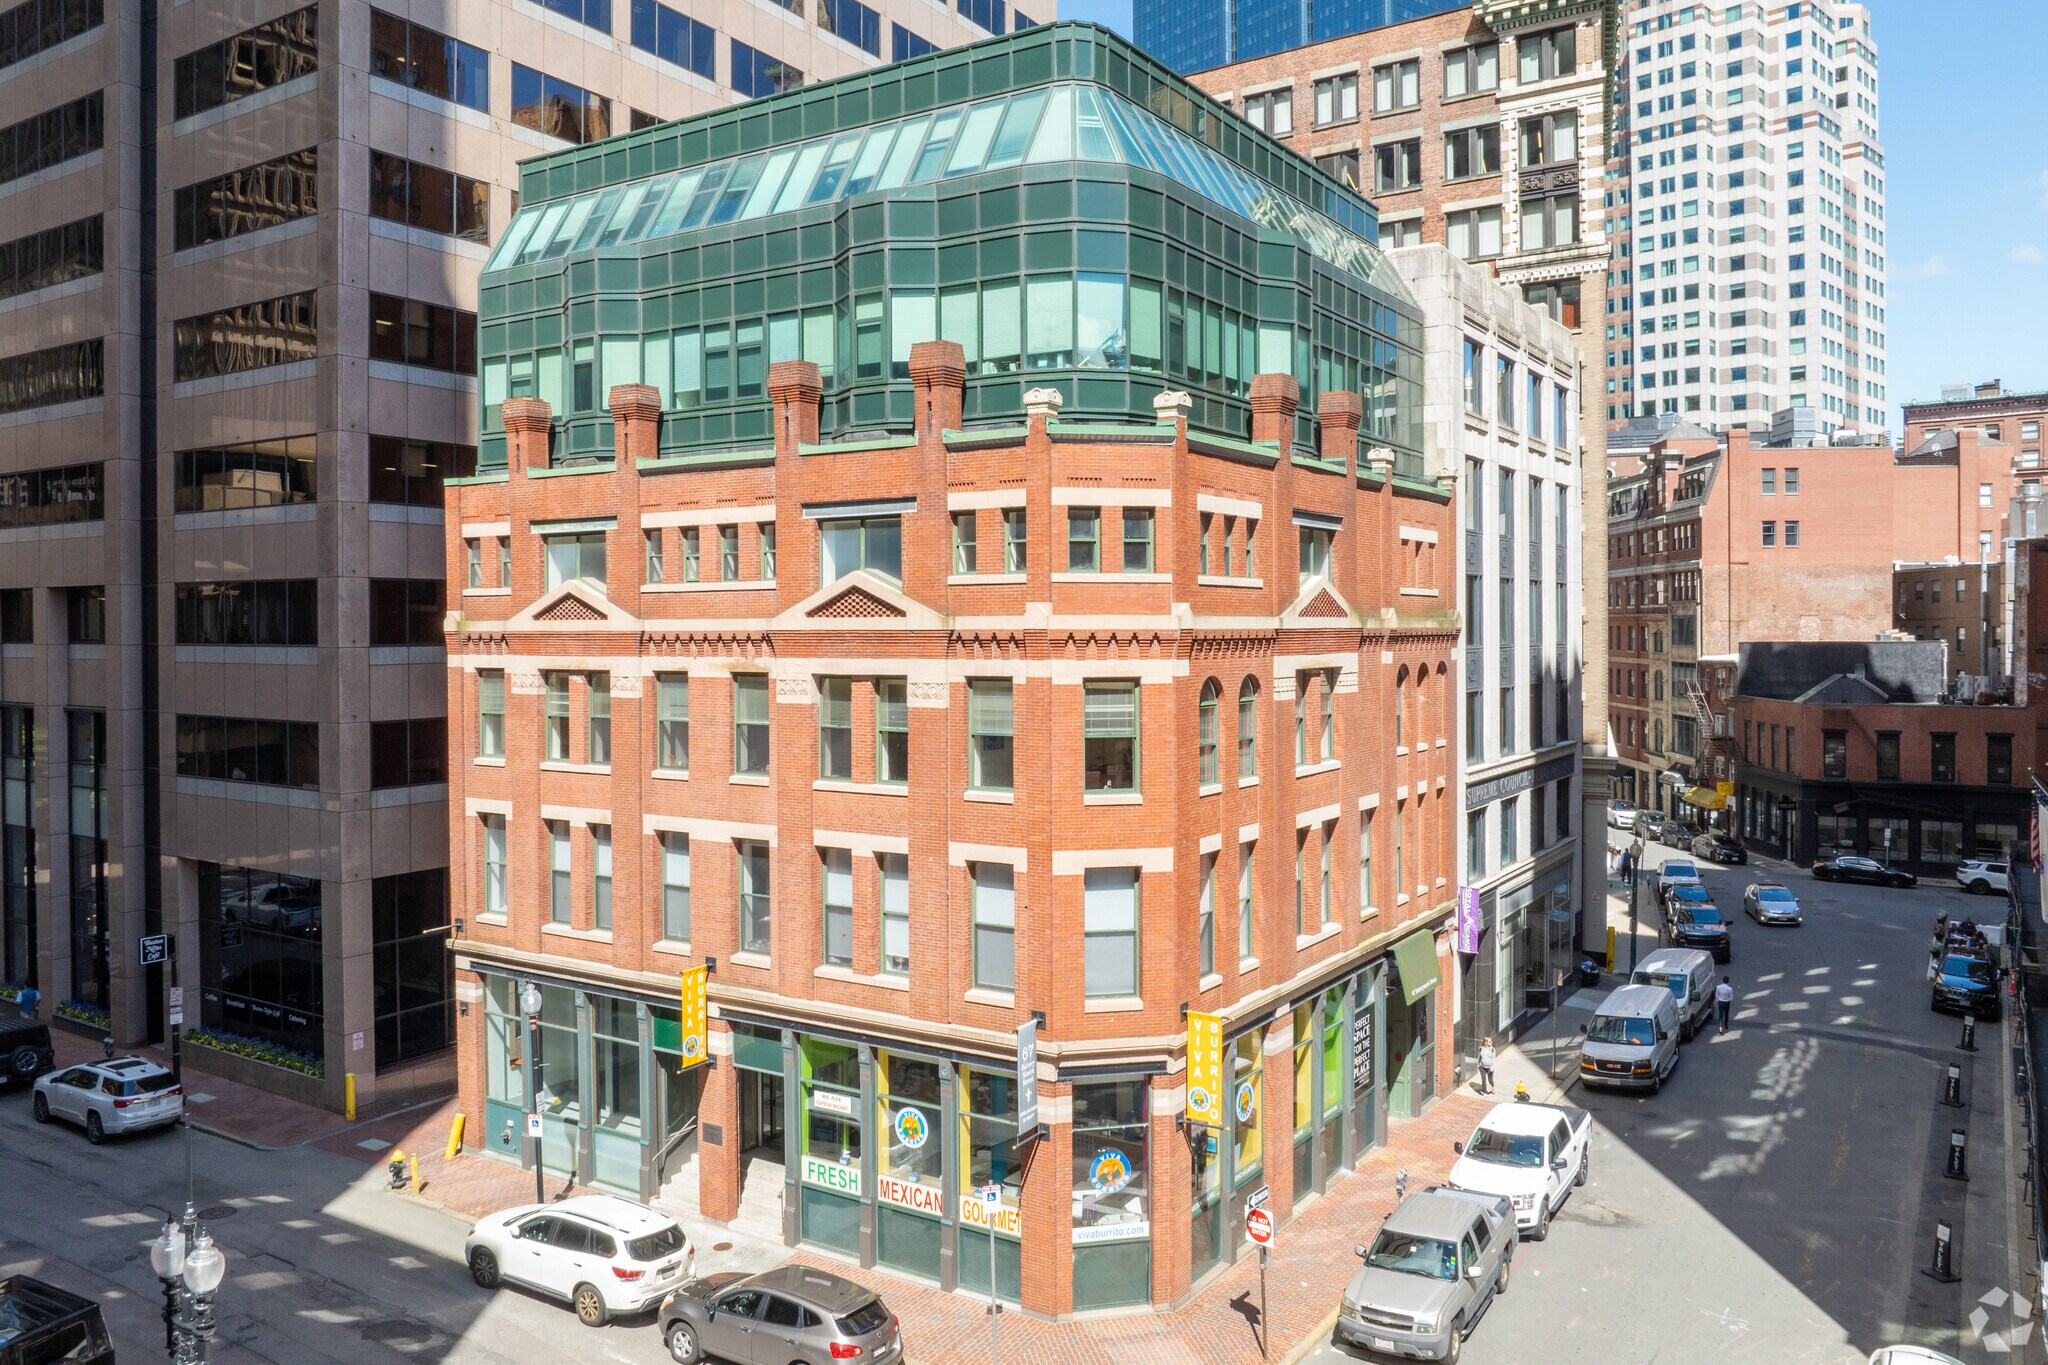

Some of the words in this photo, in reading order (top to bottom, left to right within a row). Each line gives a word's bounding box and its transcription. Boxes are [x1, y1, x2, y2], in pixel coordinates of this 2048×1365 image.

[1466, 781, 1498, 805] SUPREME
[288, 1014, 307, 1026] Catering
[697, 973, 705, 1058] BURRITO
[1193, 1019, 1203, 1078] VIVA
[1362, 1038, 1371, 1051] THE
[1210, 1022, 1219, 1120] BURRITO
[1353, 1060, 1371, 1078] PLACE
[816, 1100, 832, 1108] OPEN
[1099, 1153, 1121, 1161] VIVA
[1953, 1147, 1961, 1171] VALET
[808, 1161, 858, 1192] FRESH
[1091, 1174, 1130, 1193] BURRITO
[880, 1179, 942, 1213] MEXICAN
[1249, 1214, 1257, 1222] DO
[1258, 1217, 1269, 1225] NOT
[1077, 1226, 1144, 1240] vivaburrito.com
[1251, 1227, 1267, 1238] ENTER
[1937, 1240, 1945, 1269] VALET
